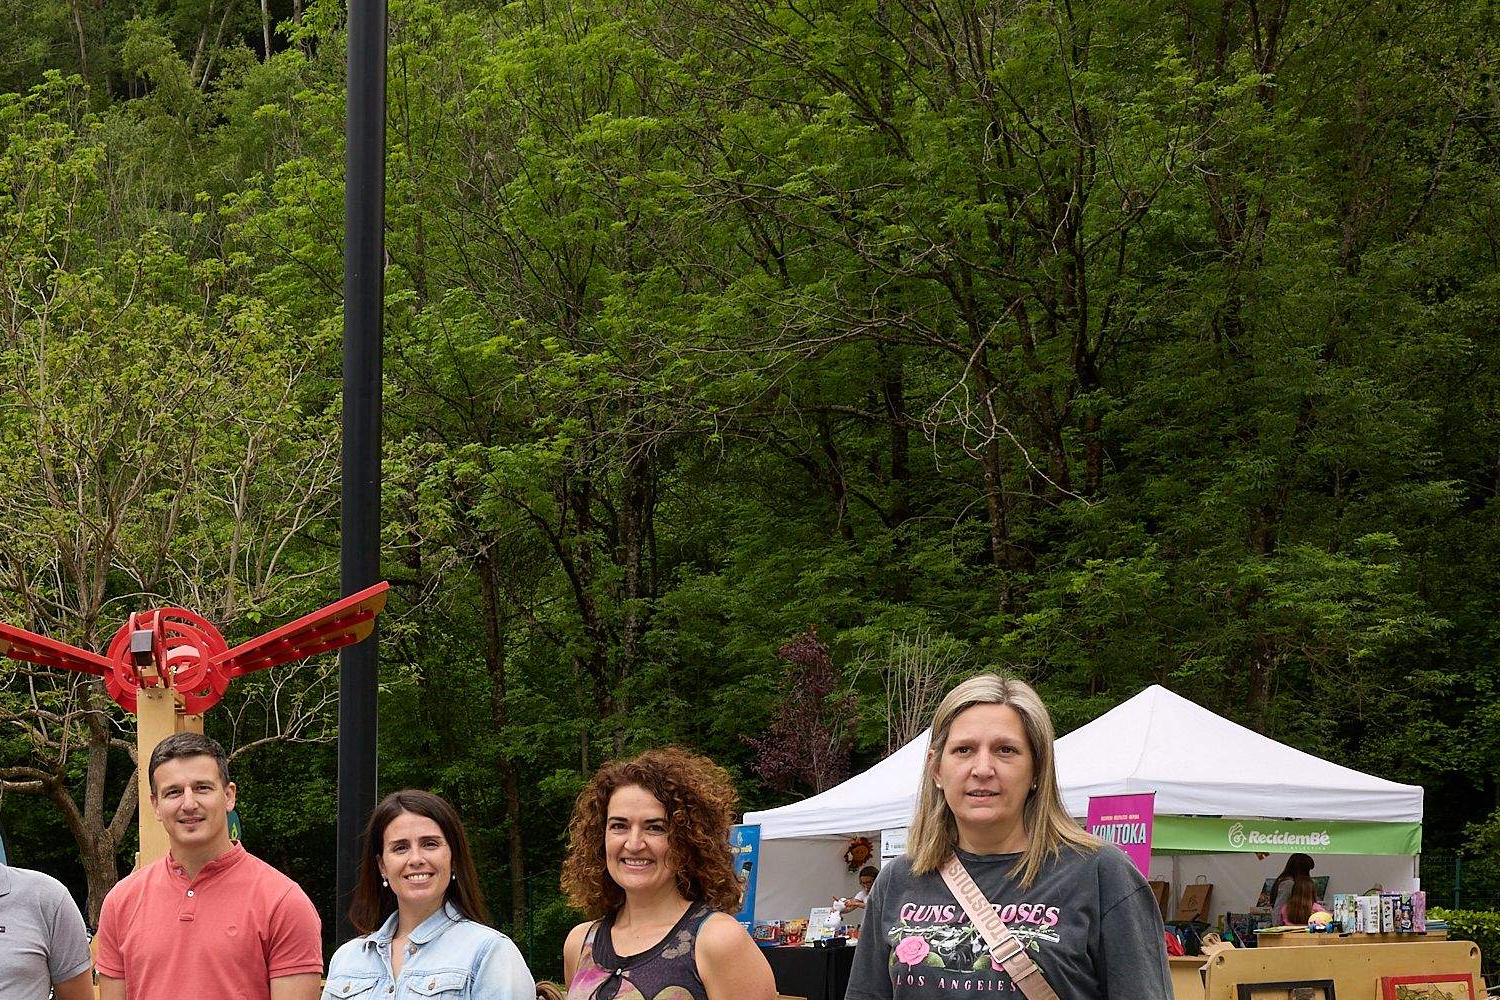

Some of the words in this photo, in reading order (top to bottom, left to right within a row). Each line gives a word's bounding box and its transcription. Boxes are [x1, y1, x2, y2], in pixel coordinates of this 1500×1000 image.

[900, 902, 956, 924] GUNS
[896, 974, 926, 987] LOS
[938, 977, 1018, 992] ANGELES
